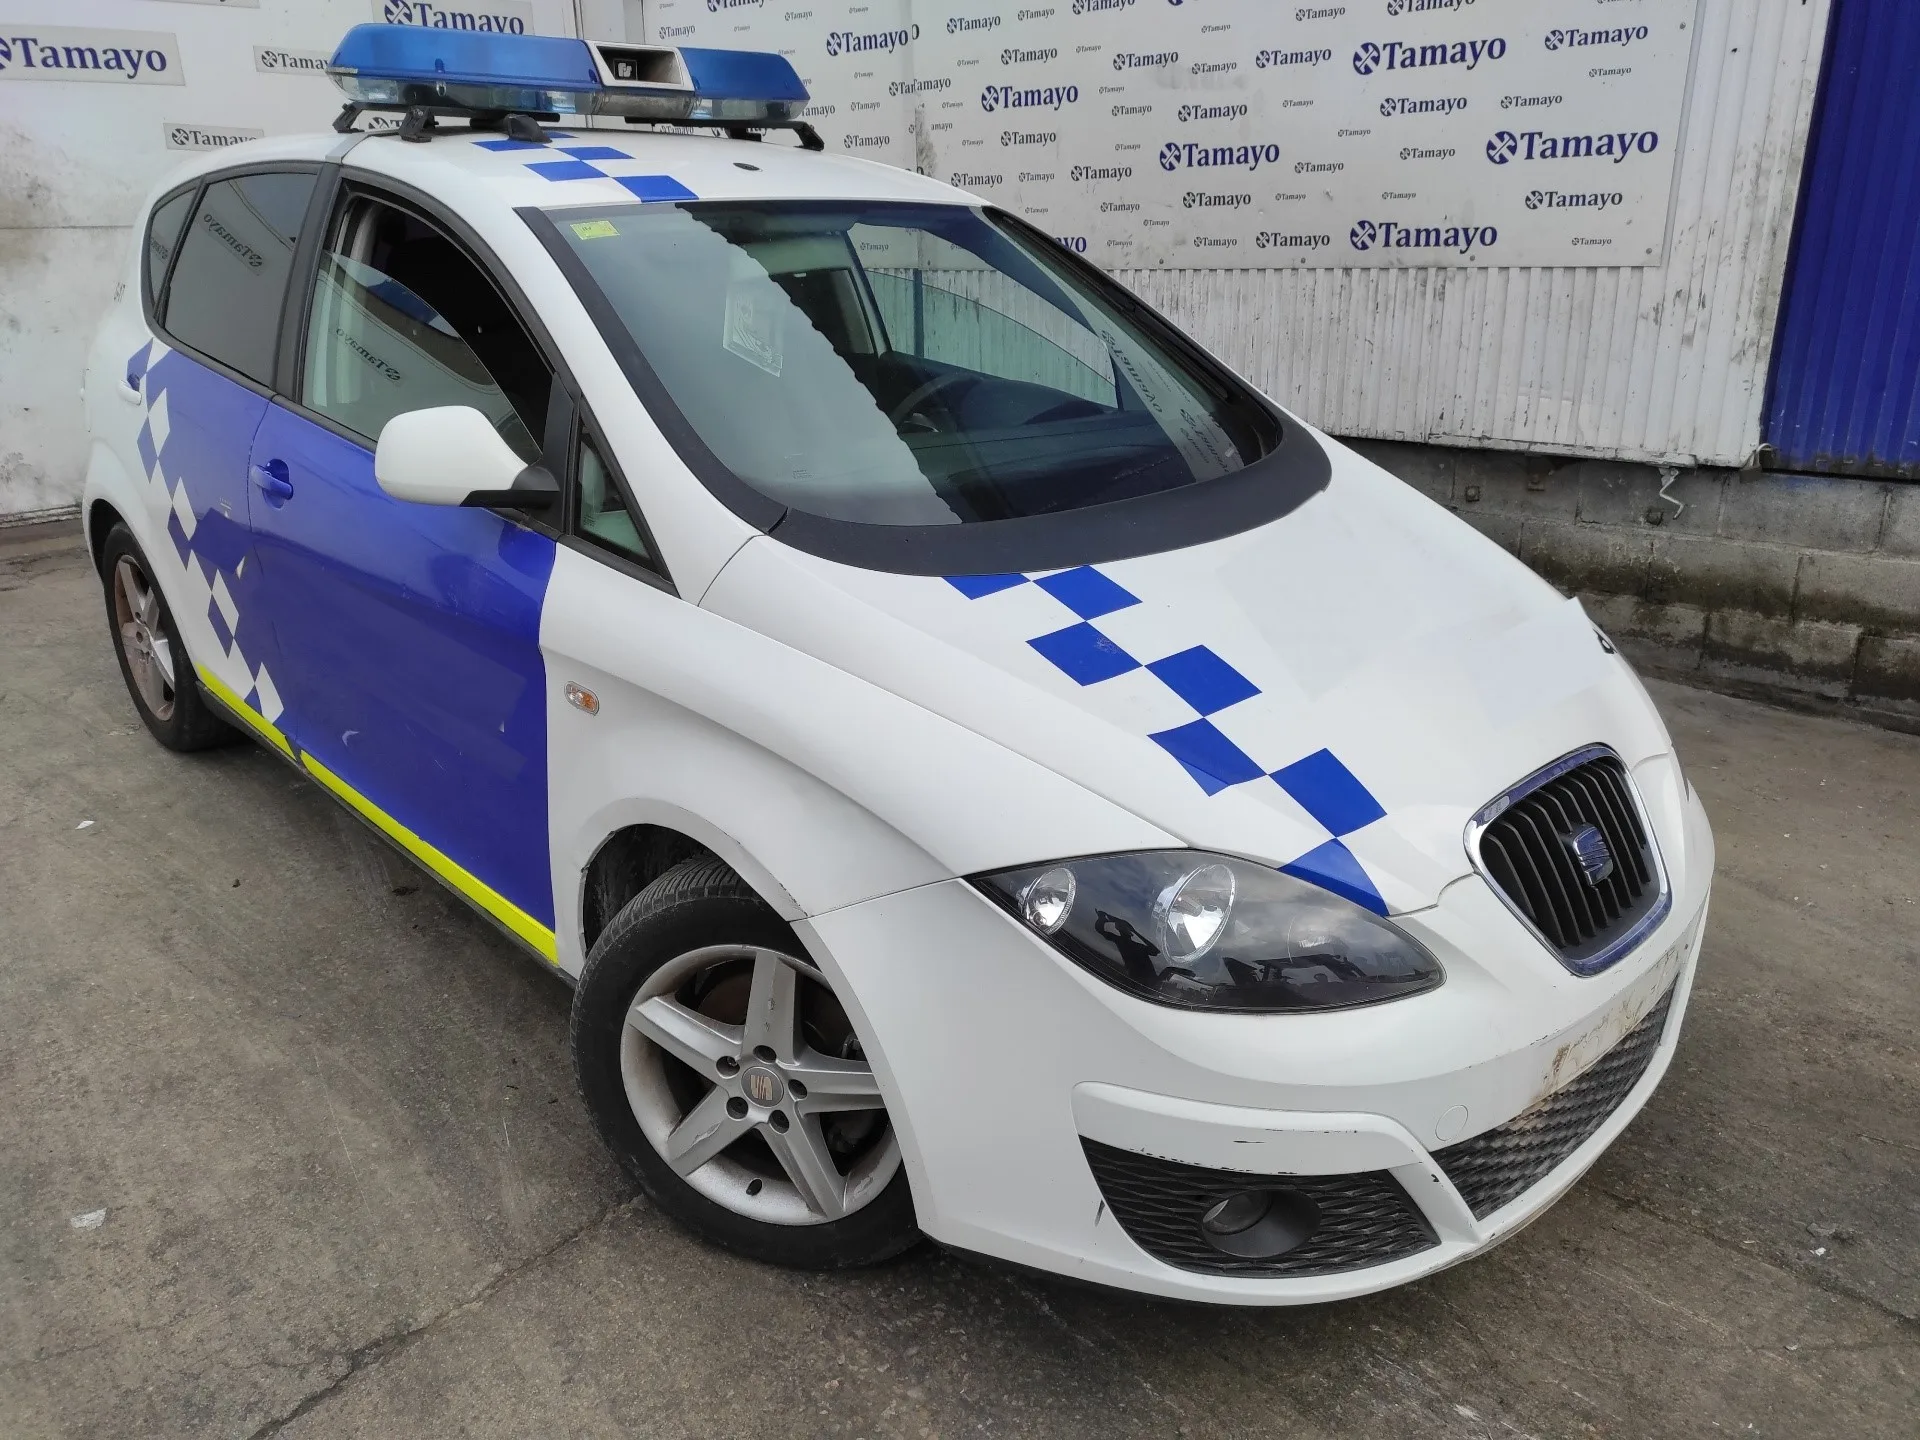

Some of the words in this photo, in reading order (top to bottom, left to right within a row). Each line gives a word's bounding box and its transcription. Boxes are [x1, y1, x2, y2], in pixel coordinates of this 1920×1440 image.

[790, 10, 812, 20] Tamayo
[1025, 7, 1055, 20] Tamayo
[1305, 5, 1346, 20] Tamayo
[666, 25, 695, 37] Tamayo
[957, 15, 1001, 32] Tamayo
[842, 29, 908, 54] Tamayo
[1565, 25, 1648, 48] Tamayo
[13, 37, 168, 79] Tamayo
[1012, 47, 1057, 64] Tamayo
[1125, 51, 1179, 68] Tamayo
[1270, 47, 1332, 66] Tamayo
[1383, 37, 1507, 70] Tamayo
[277, 53, 329, 70] Tama
[1201, 61, 1237, 74] Tamayo
[1597, 66, 1632, 78] Tamayo
[1000, 85, 1078, 111] Tamayo
[1288, 99, 1314, 108] Tamayo
[1513, 94, 1562, 108] Tamayo
[856, 101, 880, 112] Tamayo
[1118, 104, 1152, 117] Tamayo
[1192, 103, 1248, 121] Tamayo
[1398, 96, 1467, 116] Tamayo
[1012, 131, 1056, 147] Tamayo
[1344, 128, 1371, 137] Tamayo
[853, 135, 890, 148] Tamayo
[1520, 130, 1658, 163] Tamayo
[1183, 143, 1280, 171] Tamayo
[1411, 148, 1455, 160] Tamayo
[1083, 166, 1132, 183] Tamayo
[1304, 161, 1344, 173] Tamayo
[961, 173, 1003, 188] Tamayo
[1025, 172, 1055, 183] Tamayo
[1196, 192, 1251, 209] Tamayo
[1281, 193, 1306, 201] Tamayo
[1545, 191, 1623, 210] Tamayo
[1109, 202, 1140, 214] Tamayo
[1202, 237, 1237, 248] Tamayo
[1271, 232, 1330, 250] Tamayo
[1379, 222, 1497, 254] Tamayo
[1580, 237, 1612, 246] Tamayo
